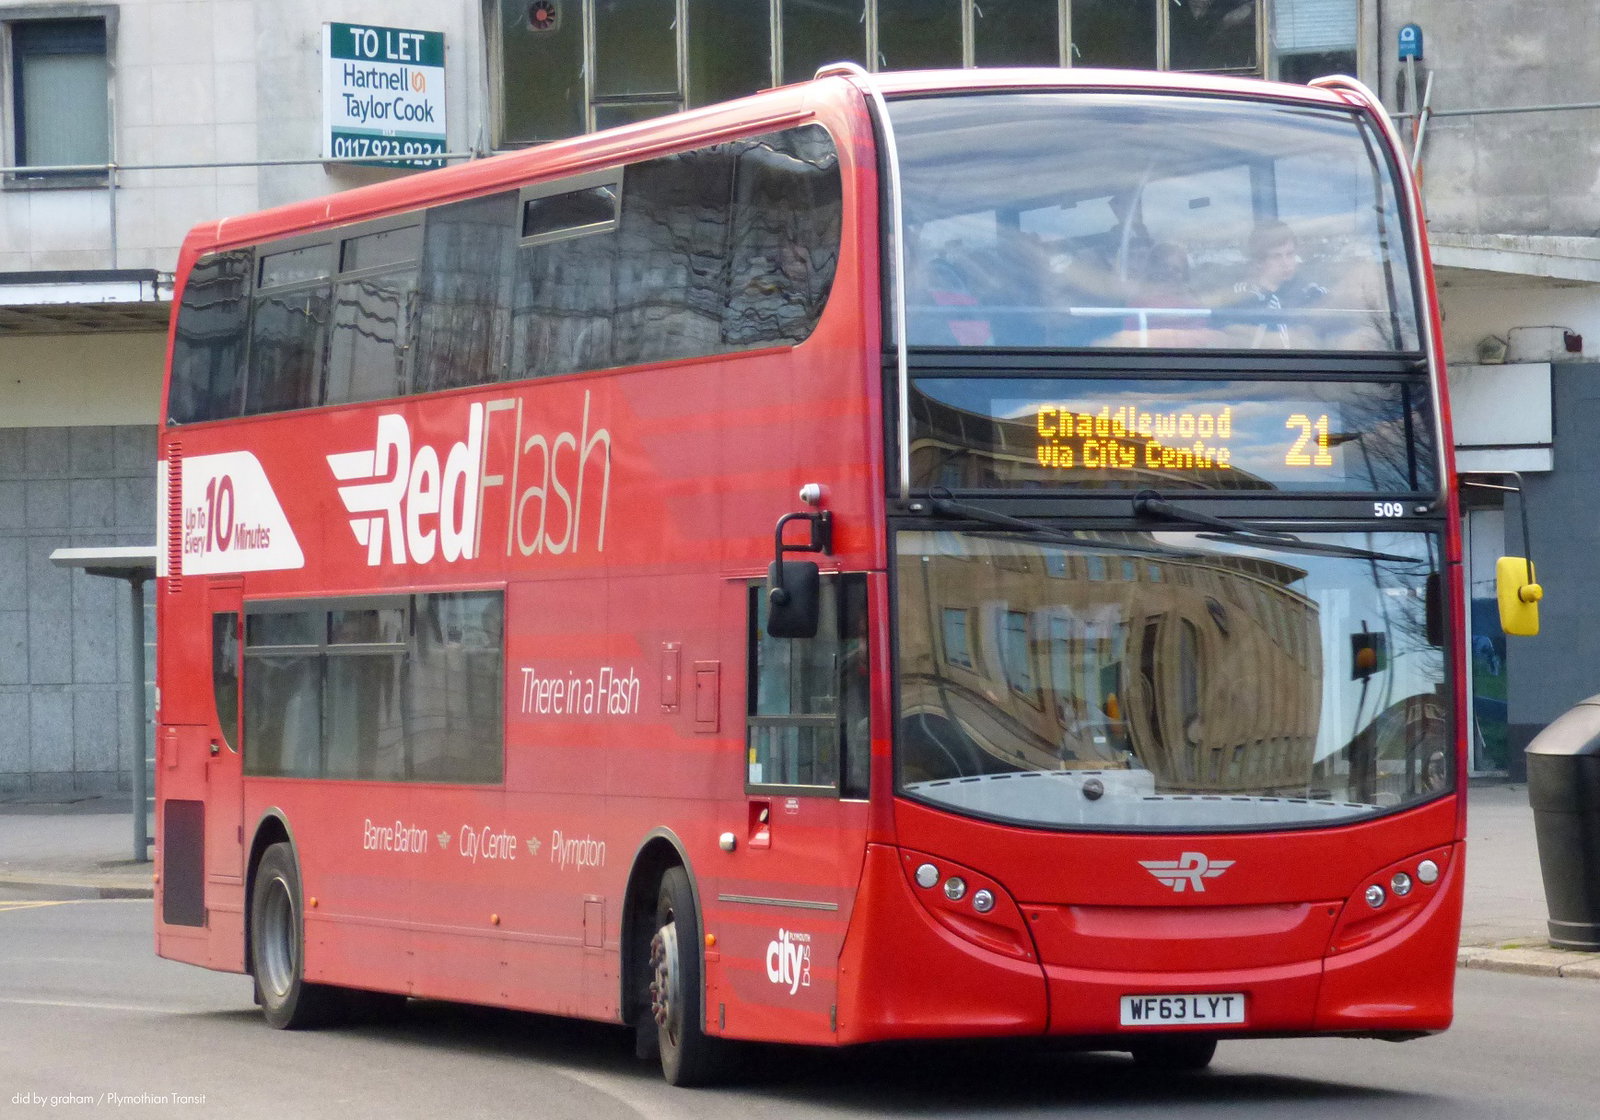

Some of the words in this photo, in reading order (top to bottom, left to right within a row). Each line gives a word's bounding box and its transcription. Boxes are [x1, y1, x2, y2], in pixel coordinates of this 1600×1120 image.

[350, 28, 379, 58] TO
[386, 31, 425, 61] LET
[343, 63, 409, 91] Hartnell
[342, 93, 392, 124] Taylor
[393, 97, 435, 123] Cook
[335, 137, 370, 158] 0117
[372, 140, 400, 163] 923
[1037, 405, 1231, 438] Chaddlewood
[1285, 414, 1333, 466] 21
[1037, 440, 1073, 468] via
[1083, 440, 1136, 468] City
[1145, 440, 1231, 468] Centre
[185, 507, 196, 535] Up
[197, 507, 206, 529] To
[206, 474, 234, 552] 10
[1374, 502, 1404, 517] 509
[185, 531, 206, 558] Every
[233, 522, 270, 550] Minutes
[521, 667, 564, 714] There
[566, 670, 581, 714] in
[583, 678, 594, 714] a
[597, 667, 640, 714] Flash
[363, 818, 393, 851] Barne
[394, 820, 428, 853] Barton
[459, 824, 481, 864] City
[481, 826, 518, 860] Centre
[551, 830, 606, 872] Plympton
[766, 928, 803, 995] city
[801, 945, 811, 986] bus
[1131, 997, 1187, 1020] WF63
[1193, 996, 1235, 1018] LYT
